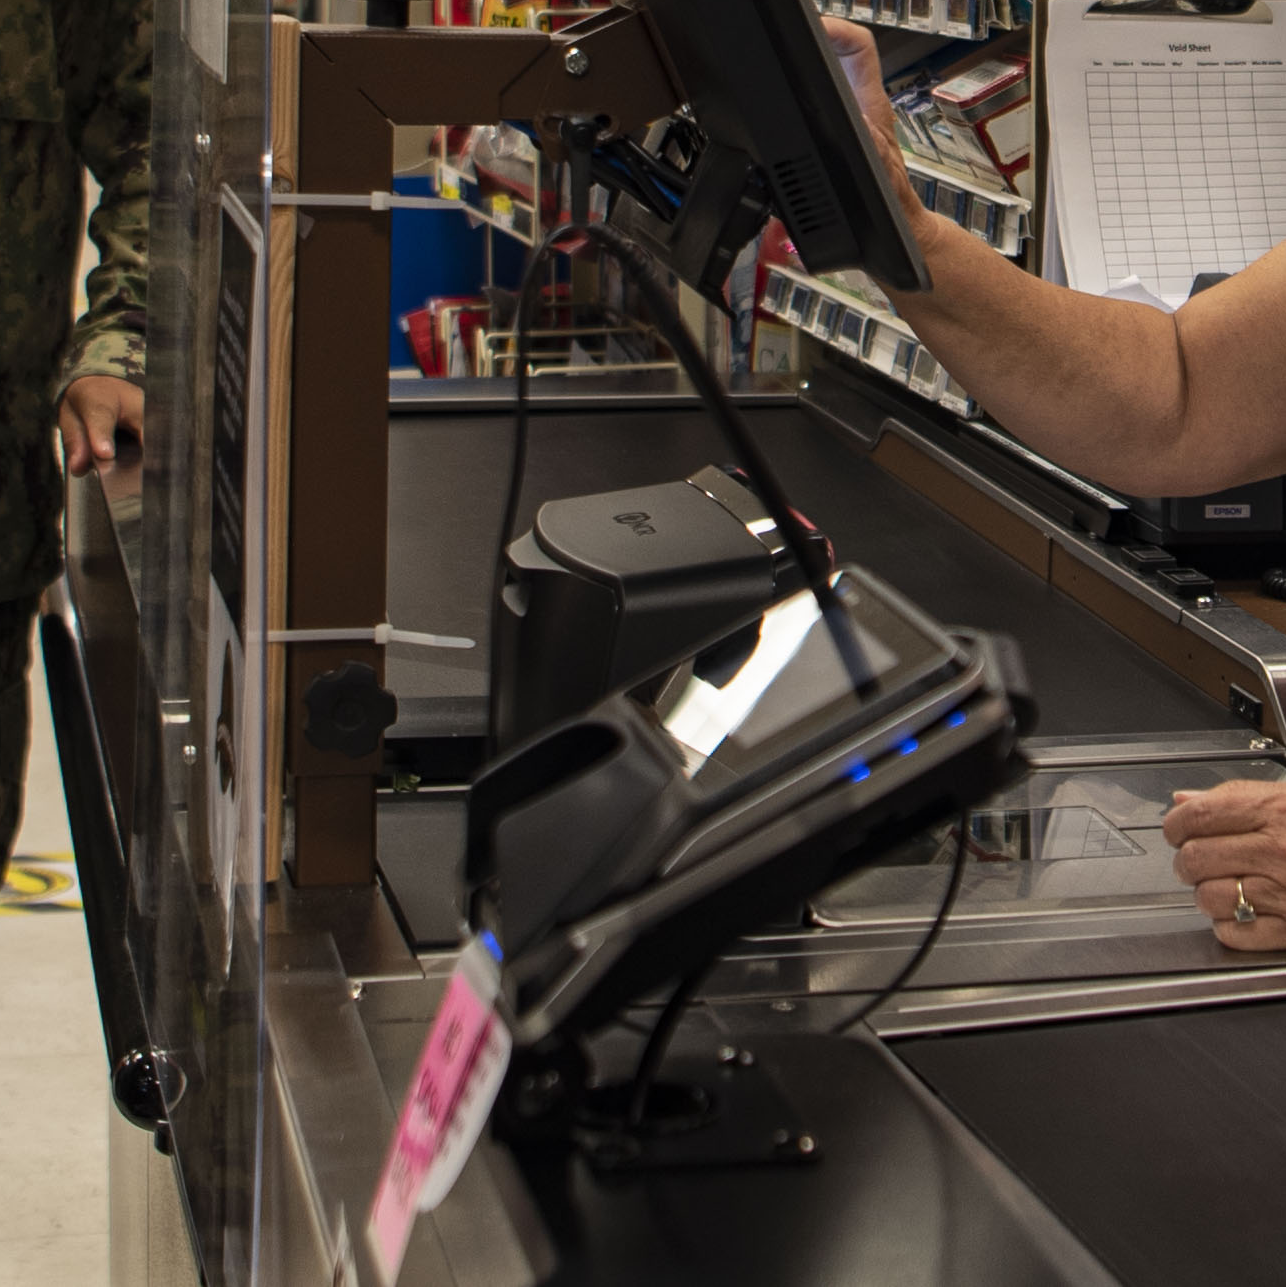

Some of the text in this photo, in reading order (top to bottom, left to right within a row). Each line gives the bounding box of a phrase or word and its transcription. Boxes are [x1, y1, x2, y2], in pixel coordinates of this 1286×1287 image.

[1169, 44, 1211, 53] Void Sheet
[1214, 506, 1243, 516] EPSON
